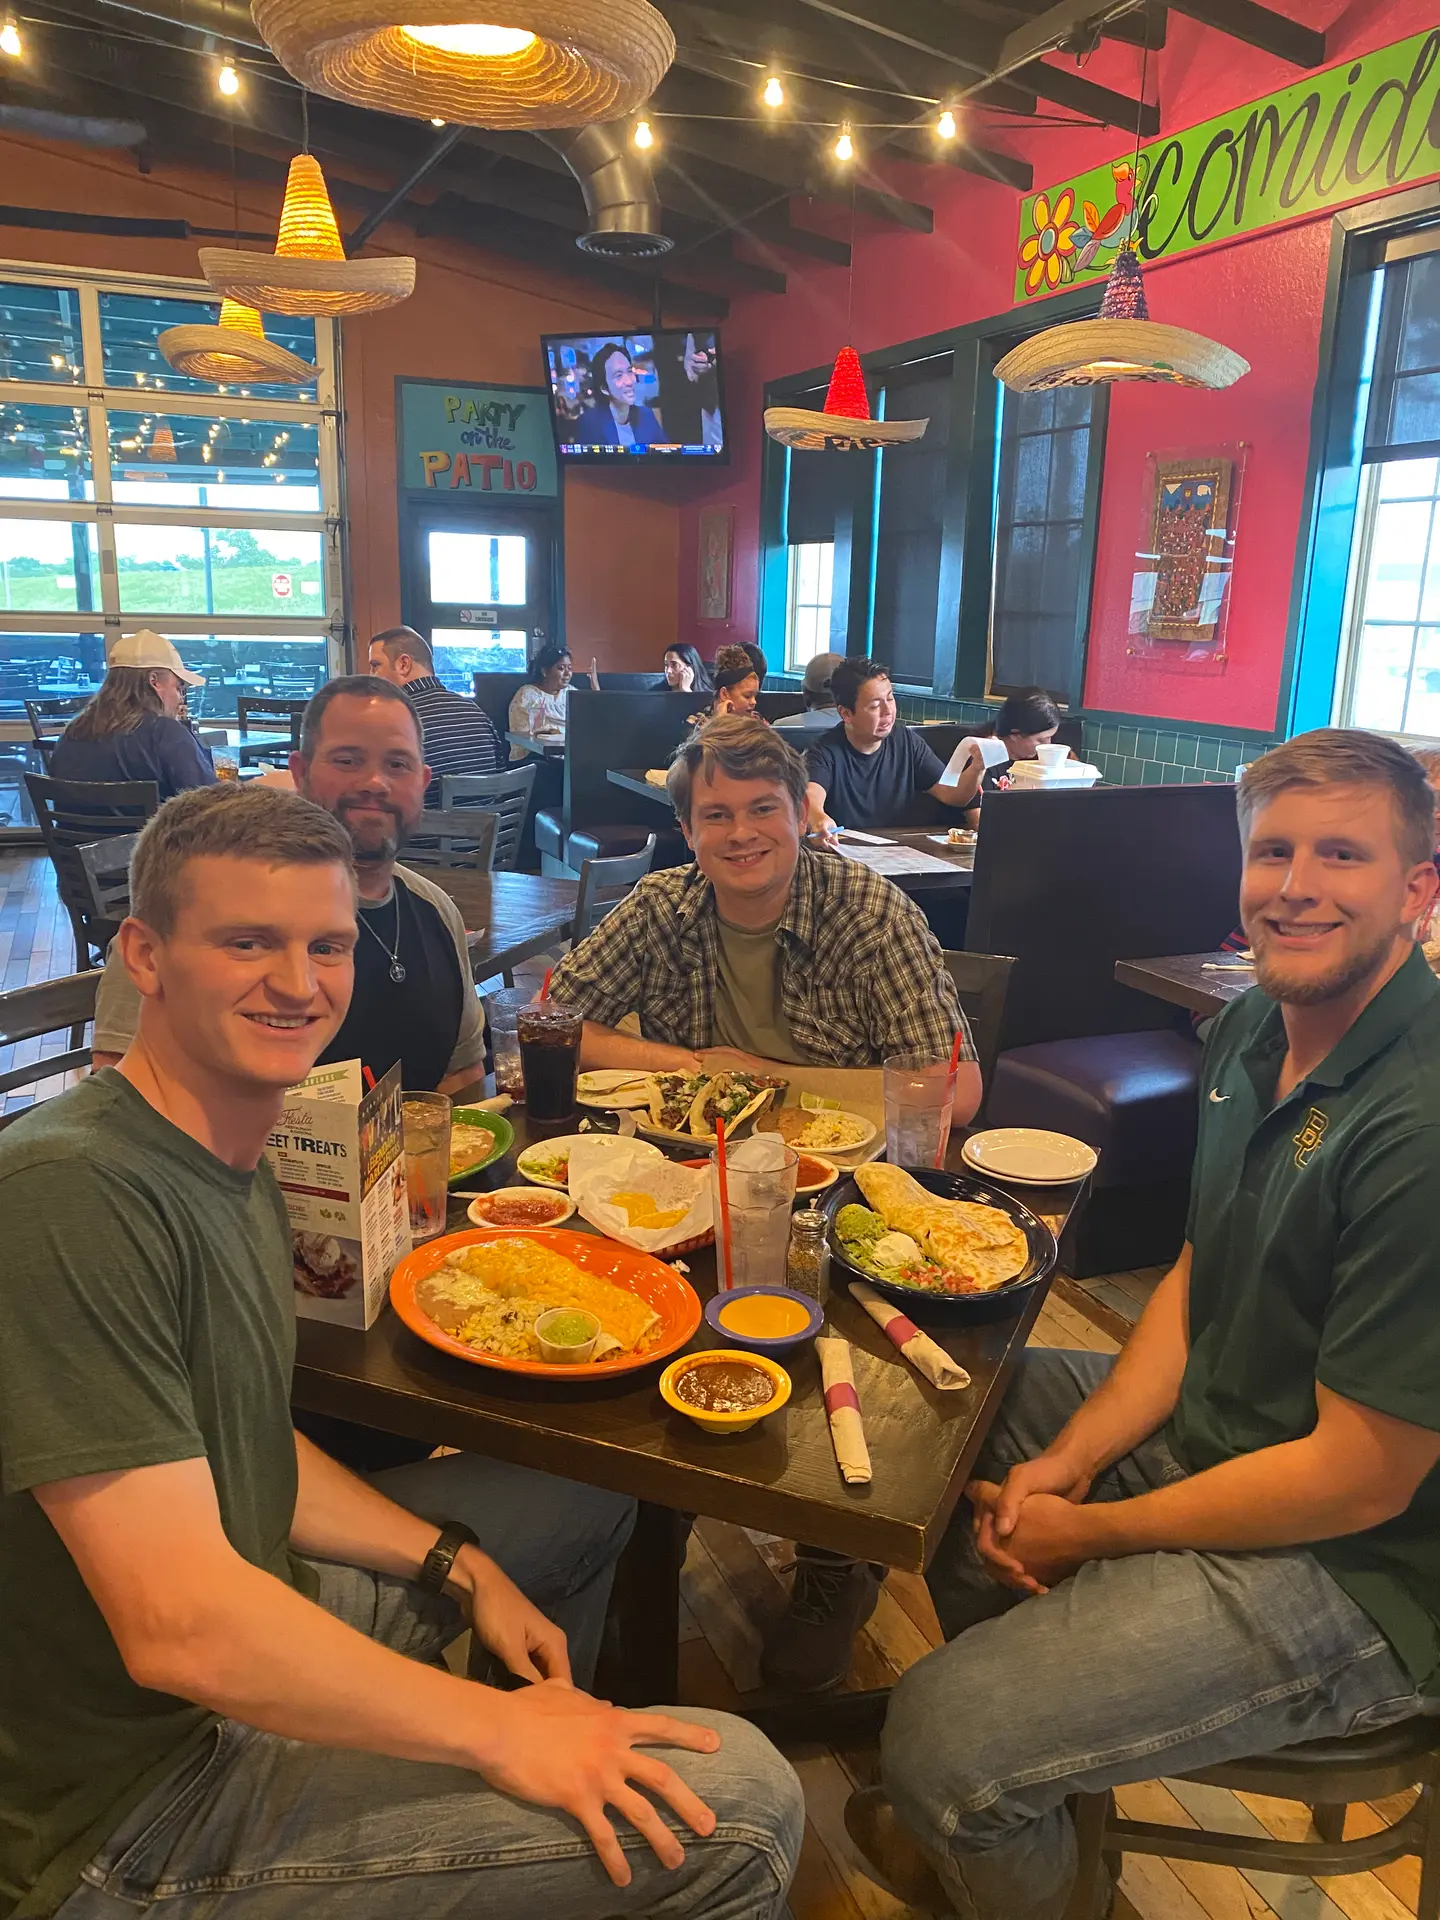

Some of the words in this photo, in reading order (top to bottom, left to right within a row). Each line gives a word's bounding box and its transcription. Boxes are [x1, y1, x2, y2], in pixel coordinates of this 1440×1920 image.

[444, 396, 526, 431] PARTY
[461, 430, 482, 446] on
[479, 427, 515, 450] the
[419, 451, 537, 491] PATIO
[277, 1106, 314, 1126] Fiesta
[266, 1133, 289, 1149] EET
[293, 1136, 347, 1158] TREATS
